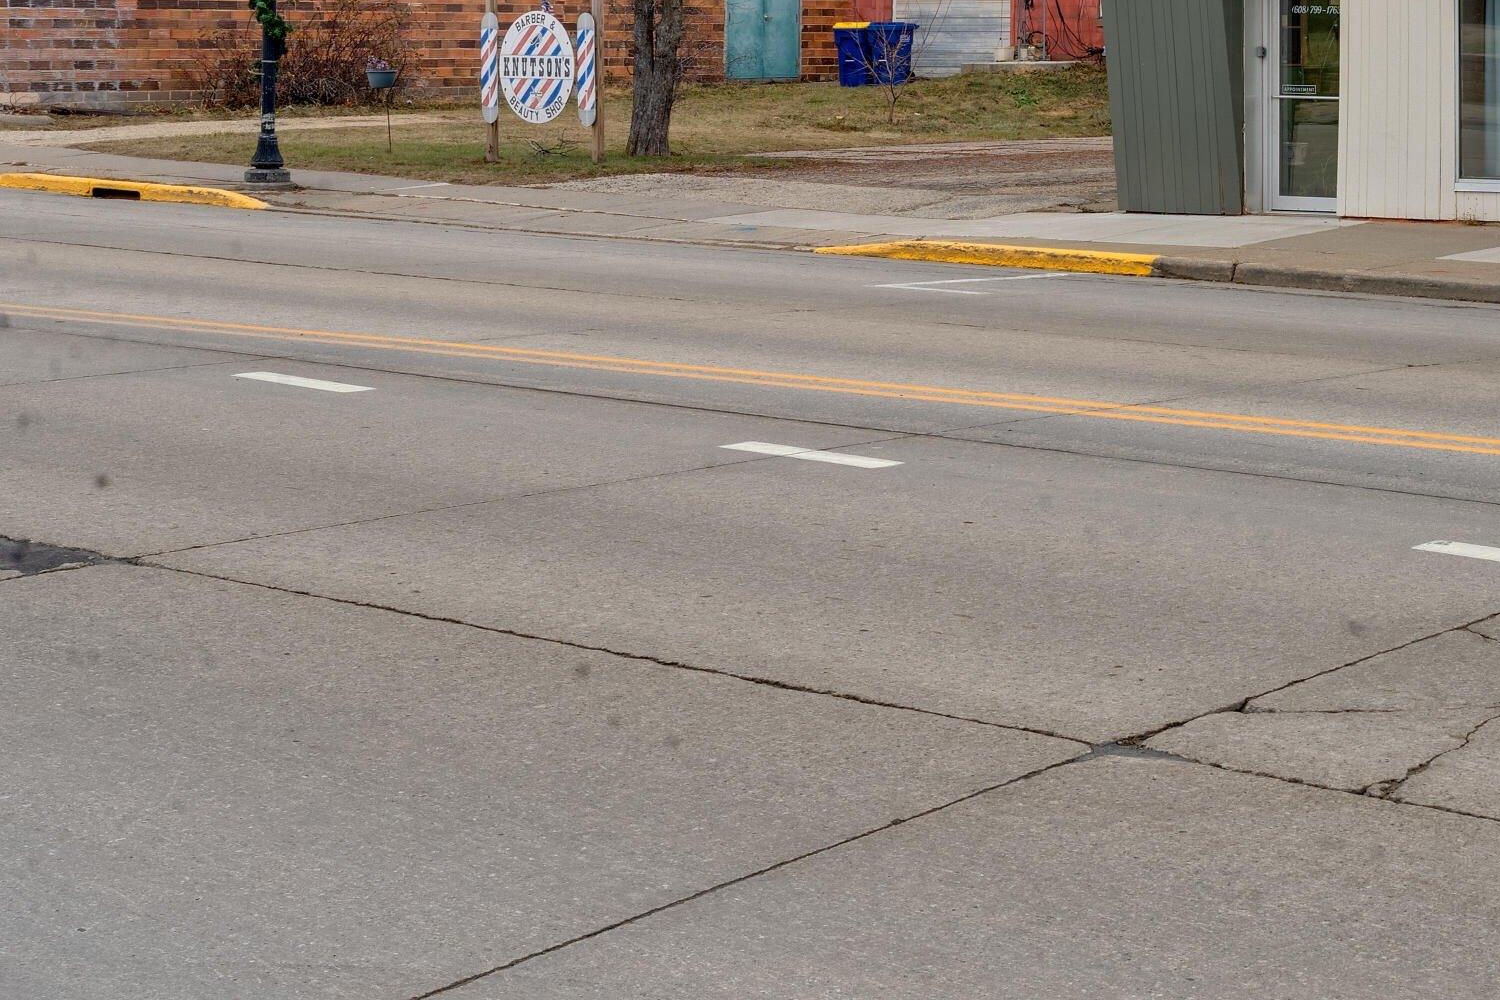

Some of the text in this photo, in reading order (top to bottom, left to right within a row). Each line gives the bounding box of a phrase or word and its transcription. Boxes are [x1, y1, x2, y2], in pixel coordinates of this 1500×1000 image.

[1291, 5, 1309, 14] (608)
[515, 13, 556, 32] BARBER &
[503, 56, 571, 78] KNUTSON'S
[509, 95, 564, 121] BEAUTY SHOP
